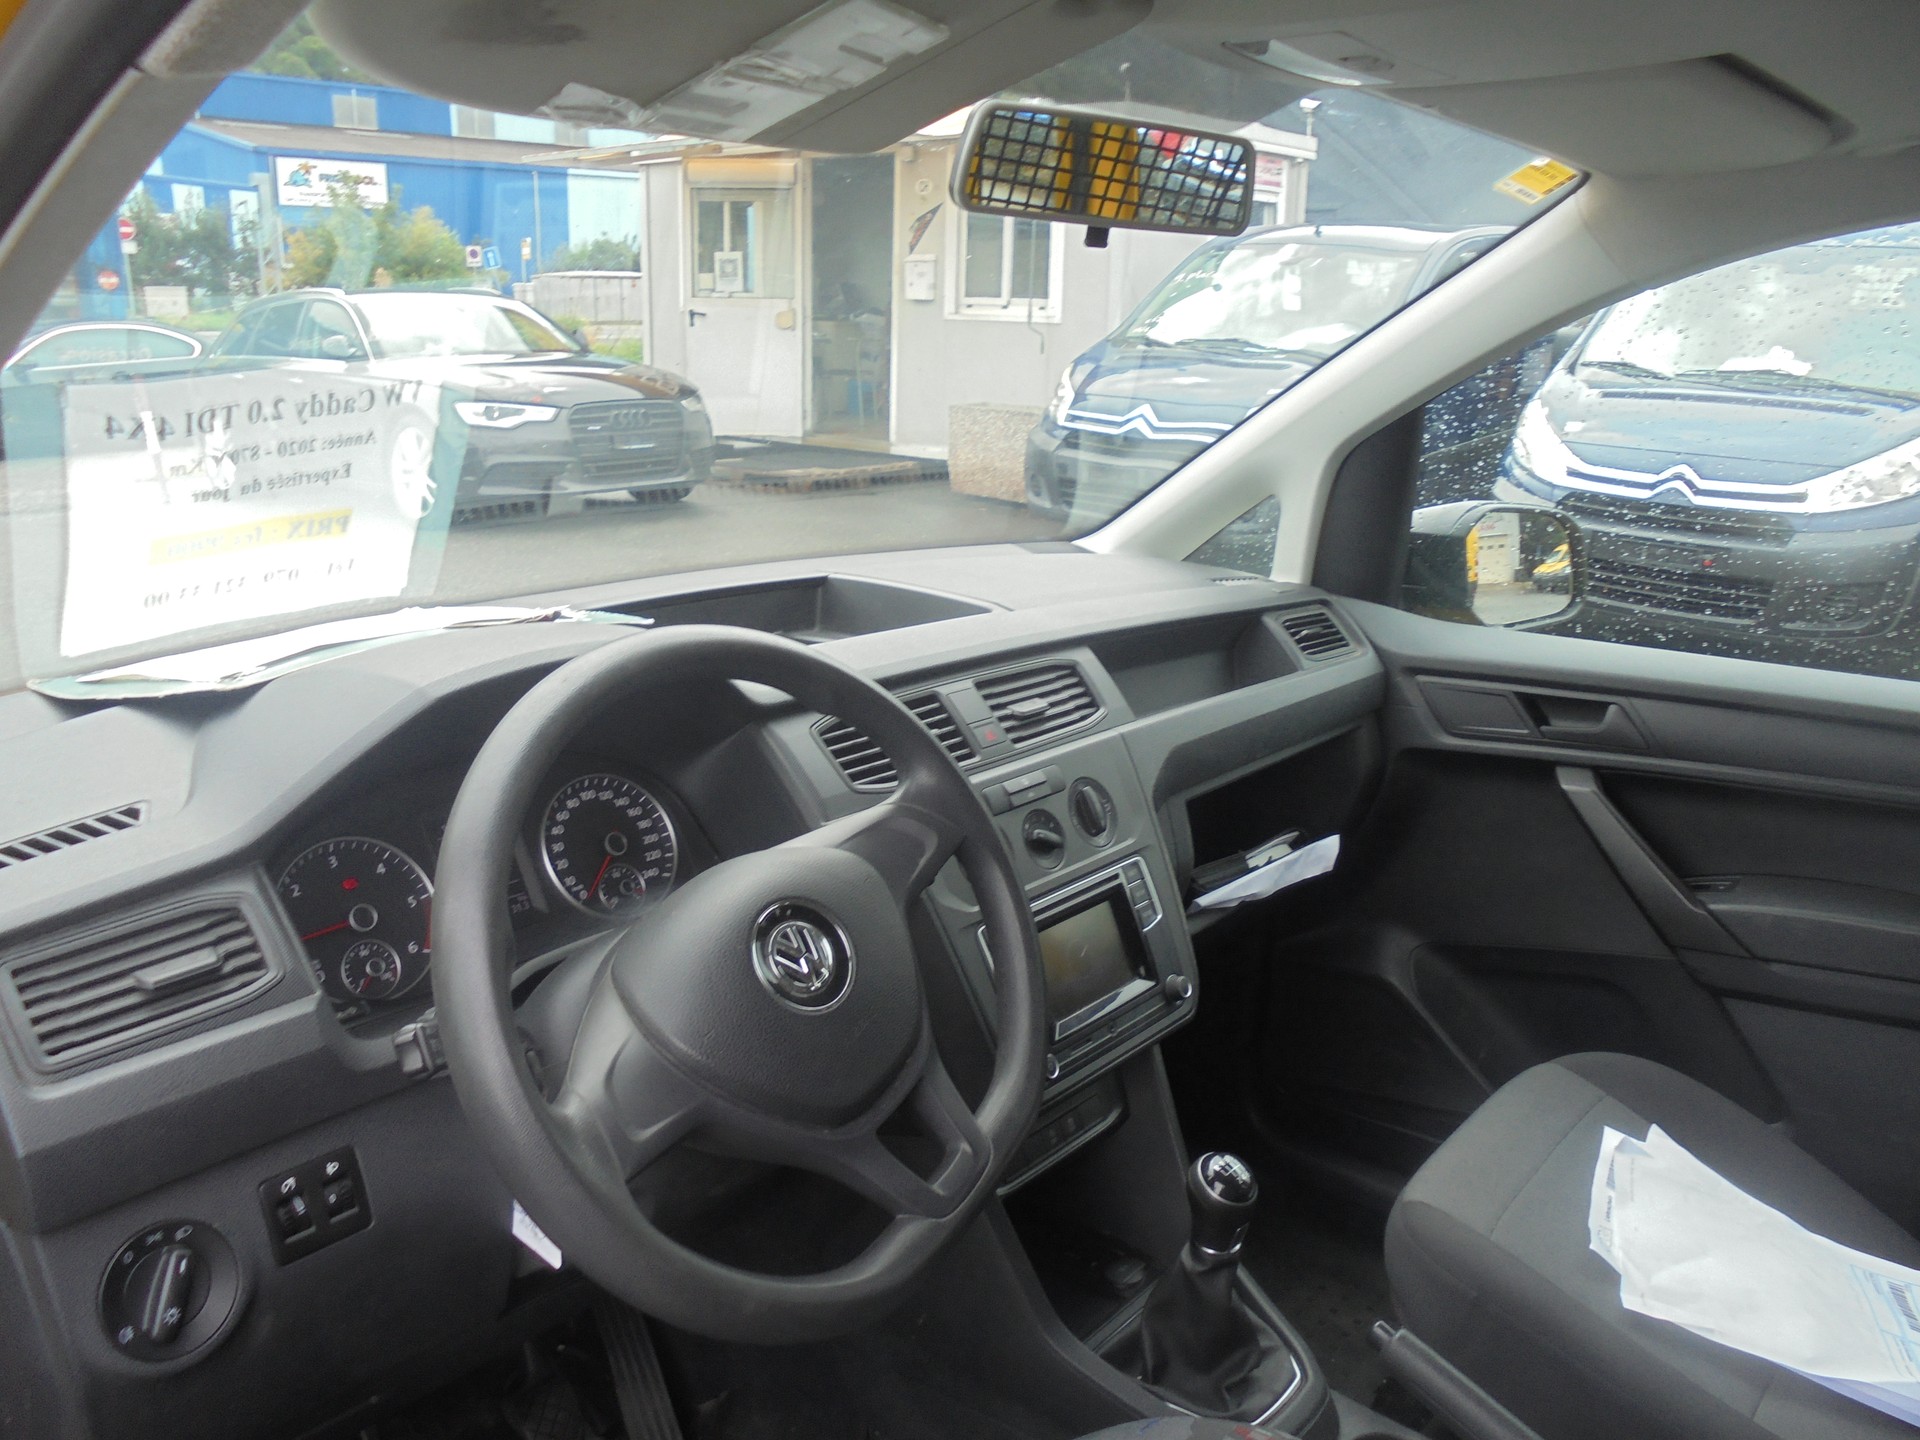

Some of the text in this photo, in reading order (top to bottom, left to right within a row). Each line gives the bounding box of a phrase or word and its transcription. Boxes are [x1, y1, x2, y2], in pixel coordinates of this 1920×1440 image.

[327, 854, 339, 869] 3
[376, 862, 387, 875] 4
[289, 884, 302, 898] 2
[407, 895, 418, 909] 5
[407, 940, 419, 954] 6
